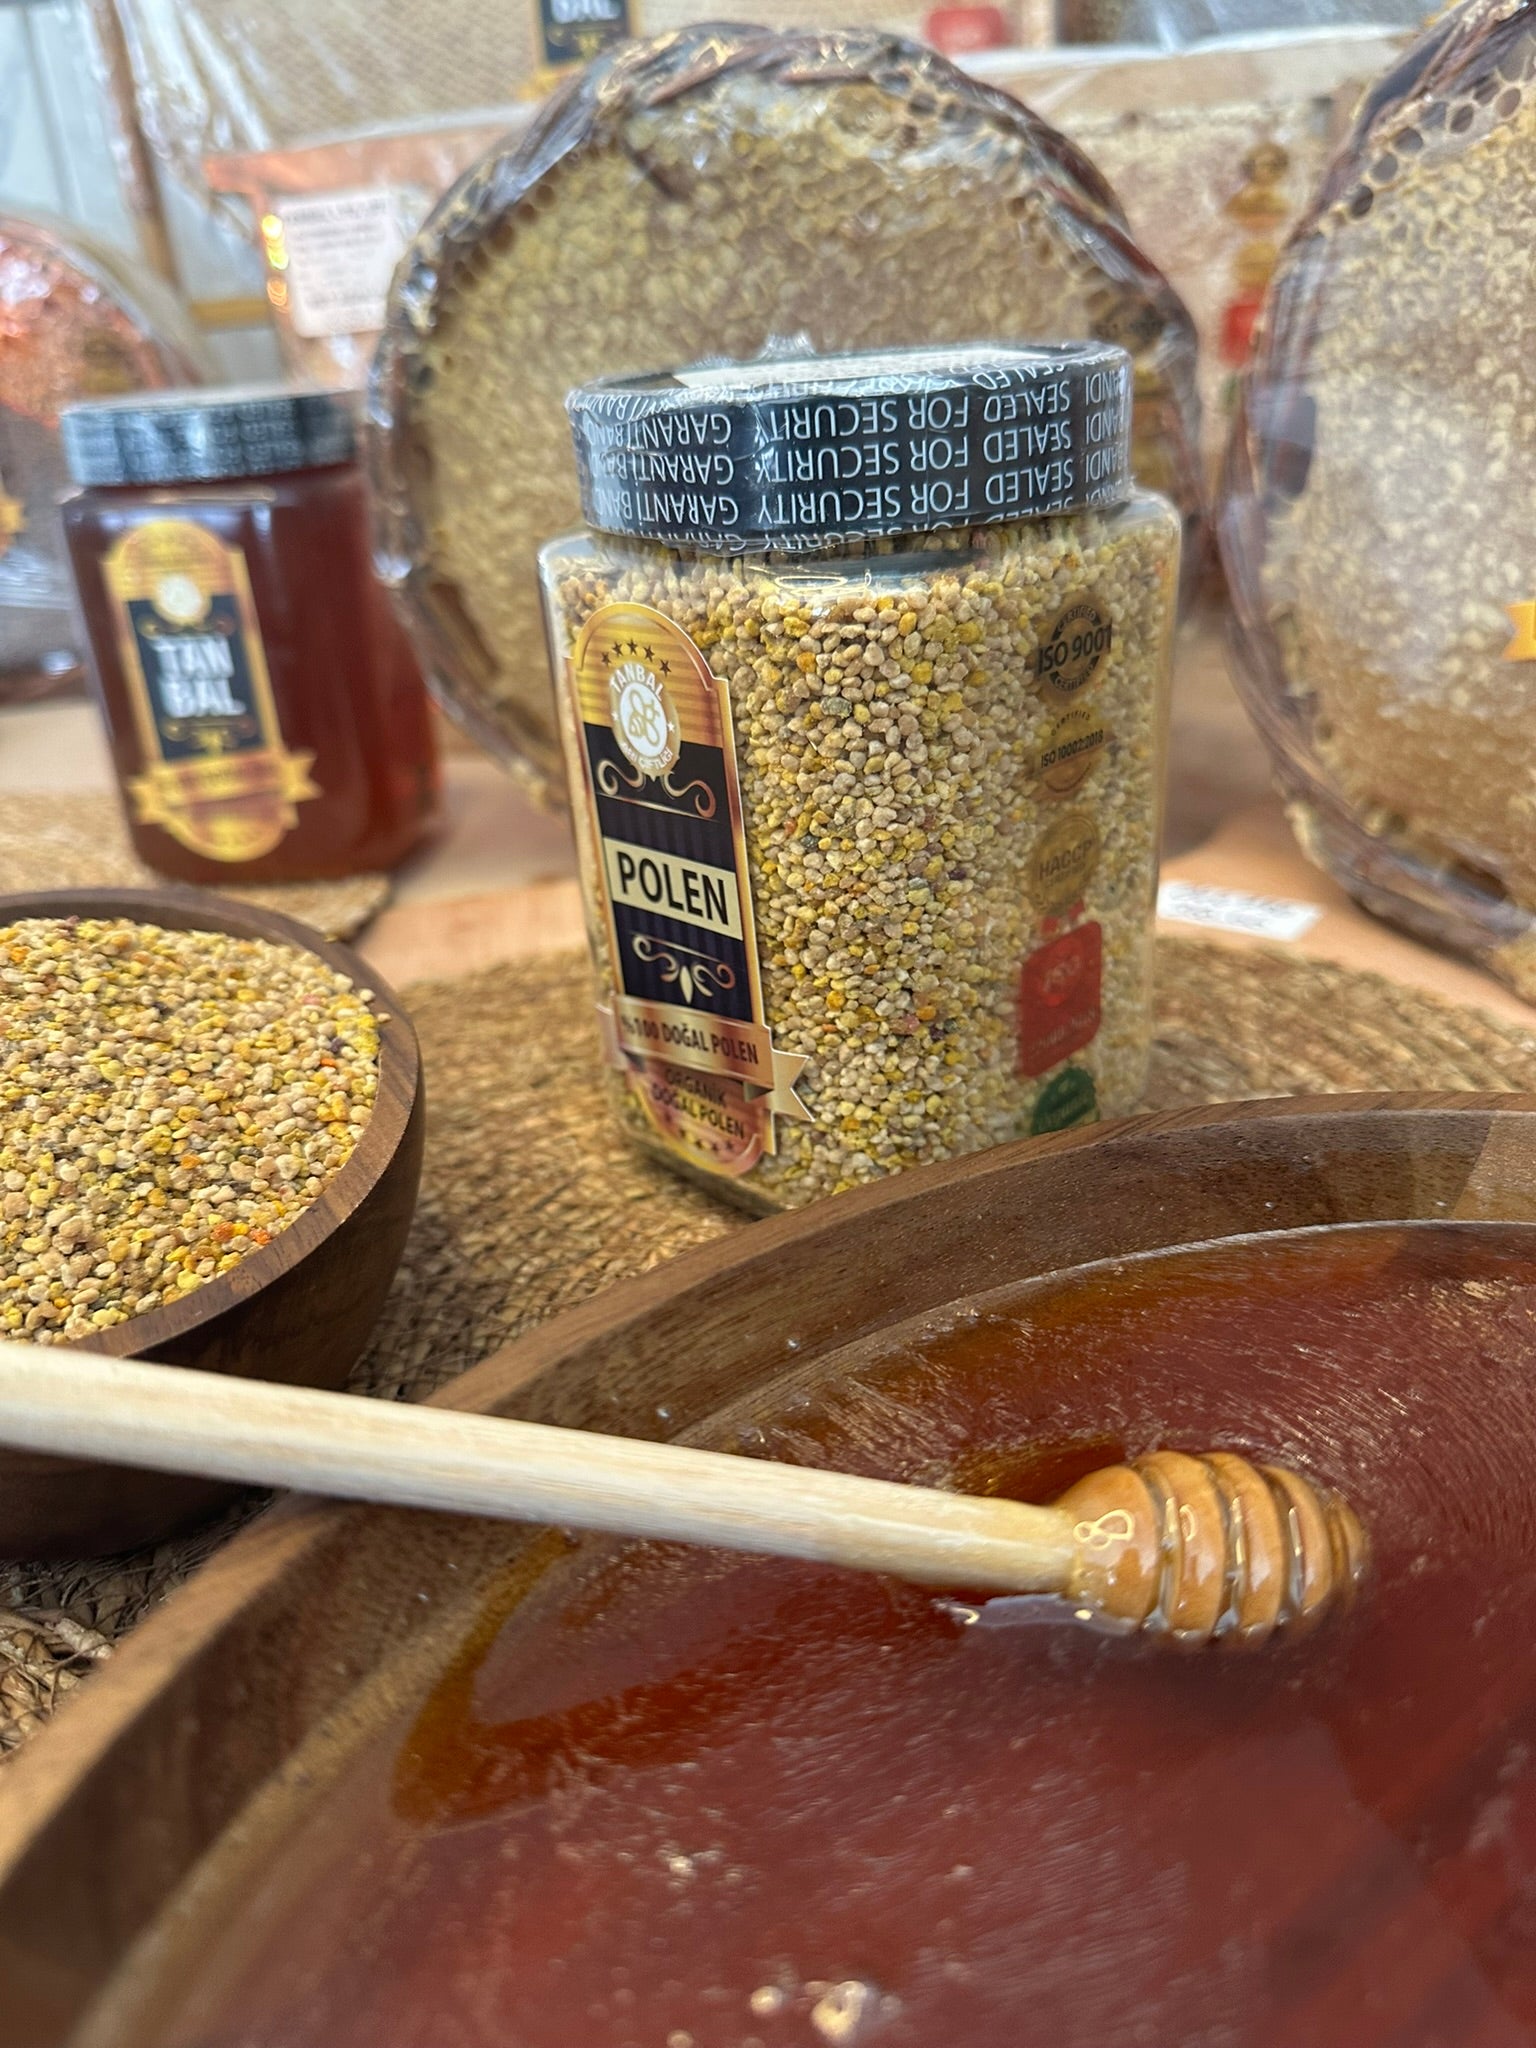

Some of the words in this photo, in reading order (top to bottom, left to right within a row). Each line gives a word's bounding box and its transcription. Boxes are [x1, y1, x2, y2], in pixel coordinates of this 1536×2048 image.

[755, 399, 898, 444] SECURITY
[908, 396, 969, 430] FOR
[983, 380, 1071, 424] SEALED
[909, 436, 969, 471] FOR
[982, 420, 1072, 463] SEALED
[632, 453, 736, 488] GARANTİ
[756, 442, 900, 484] SECURITY
[984, 458, 1073, 506] SEALED
[635, 491, 741, 527] GARANTİ
[758, 484, 902, 526] SECURITY
[911, 476, 970, 515] FOR
[1037, 642, 1068, 674] ISO
[1072, 620, 1113, 662] 9001
[609, 663, 664, 702] TANBAL
[1040, 750, 1057, 769] ISO
[616, 851, 730, 926] POLEN
[661, 1022, 709, 1052] DOĞAL
[710, 1033, 759, 1065] POLEN
[699, 1104, 745, 1140] POLEN
